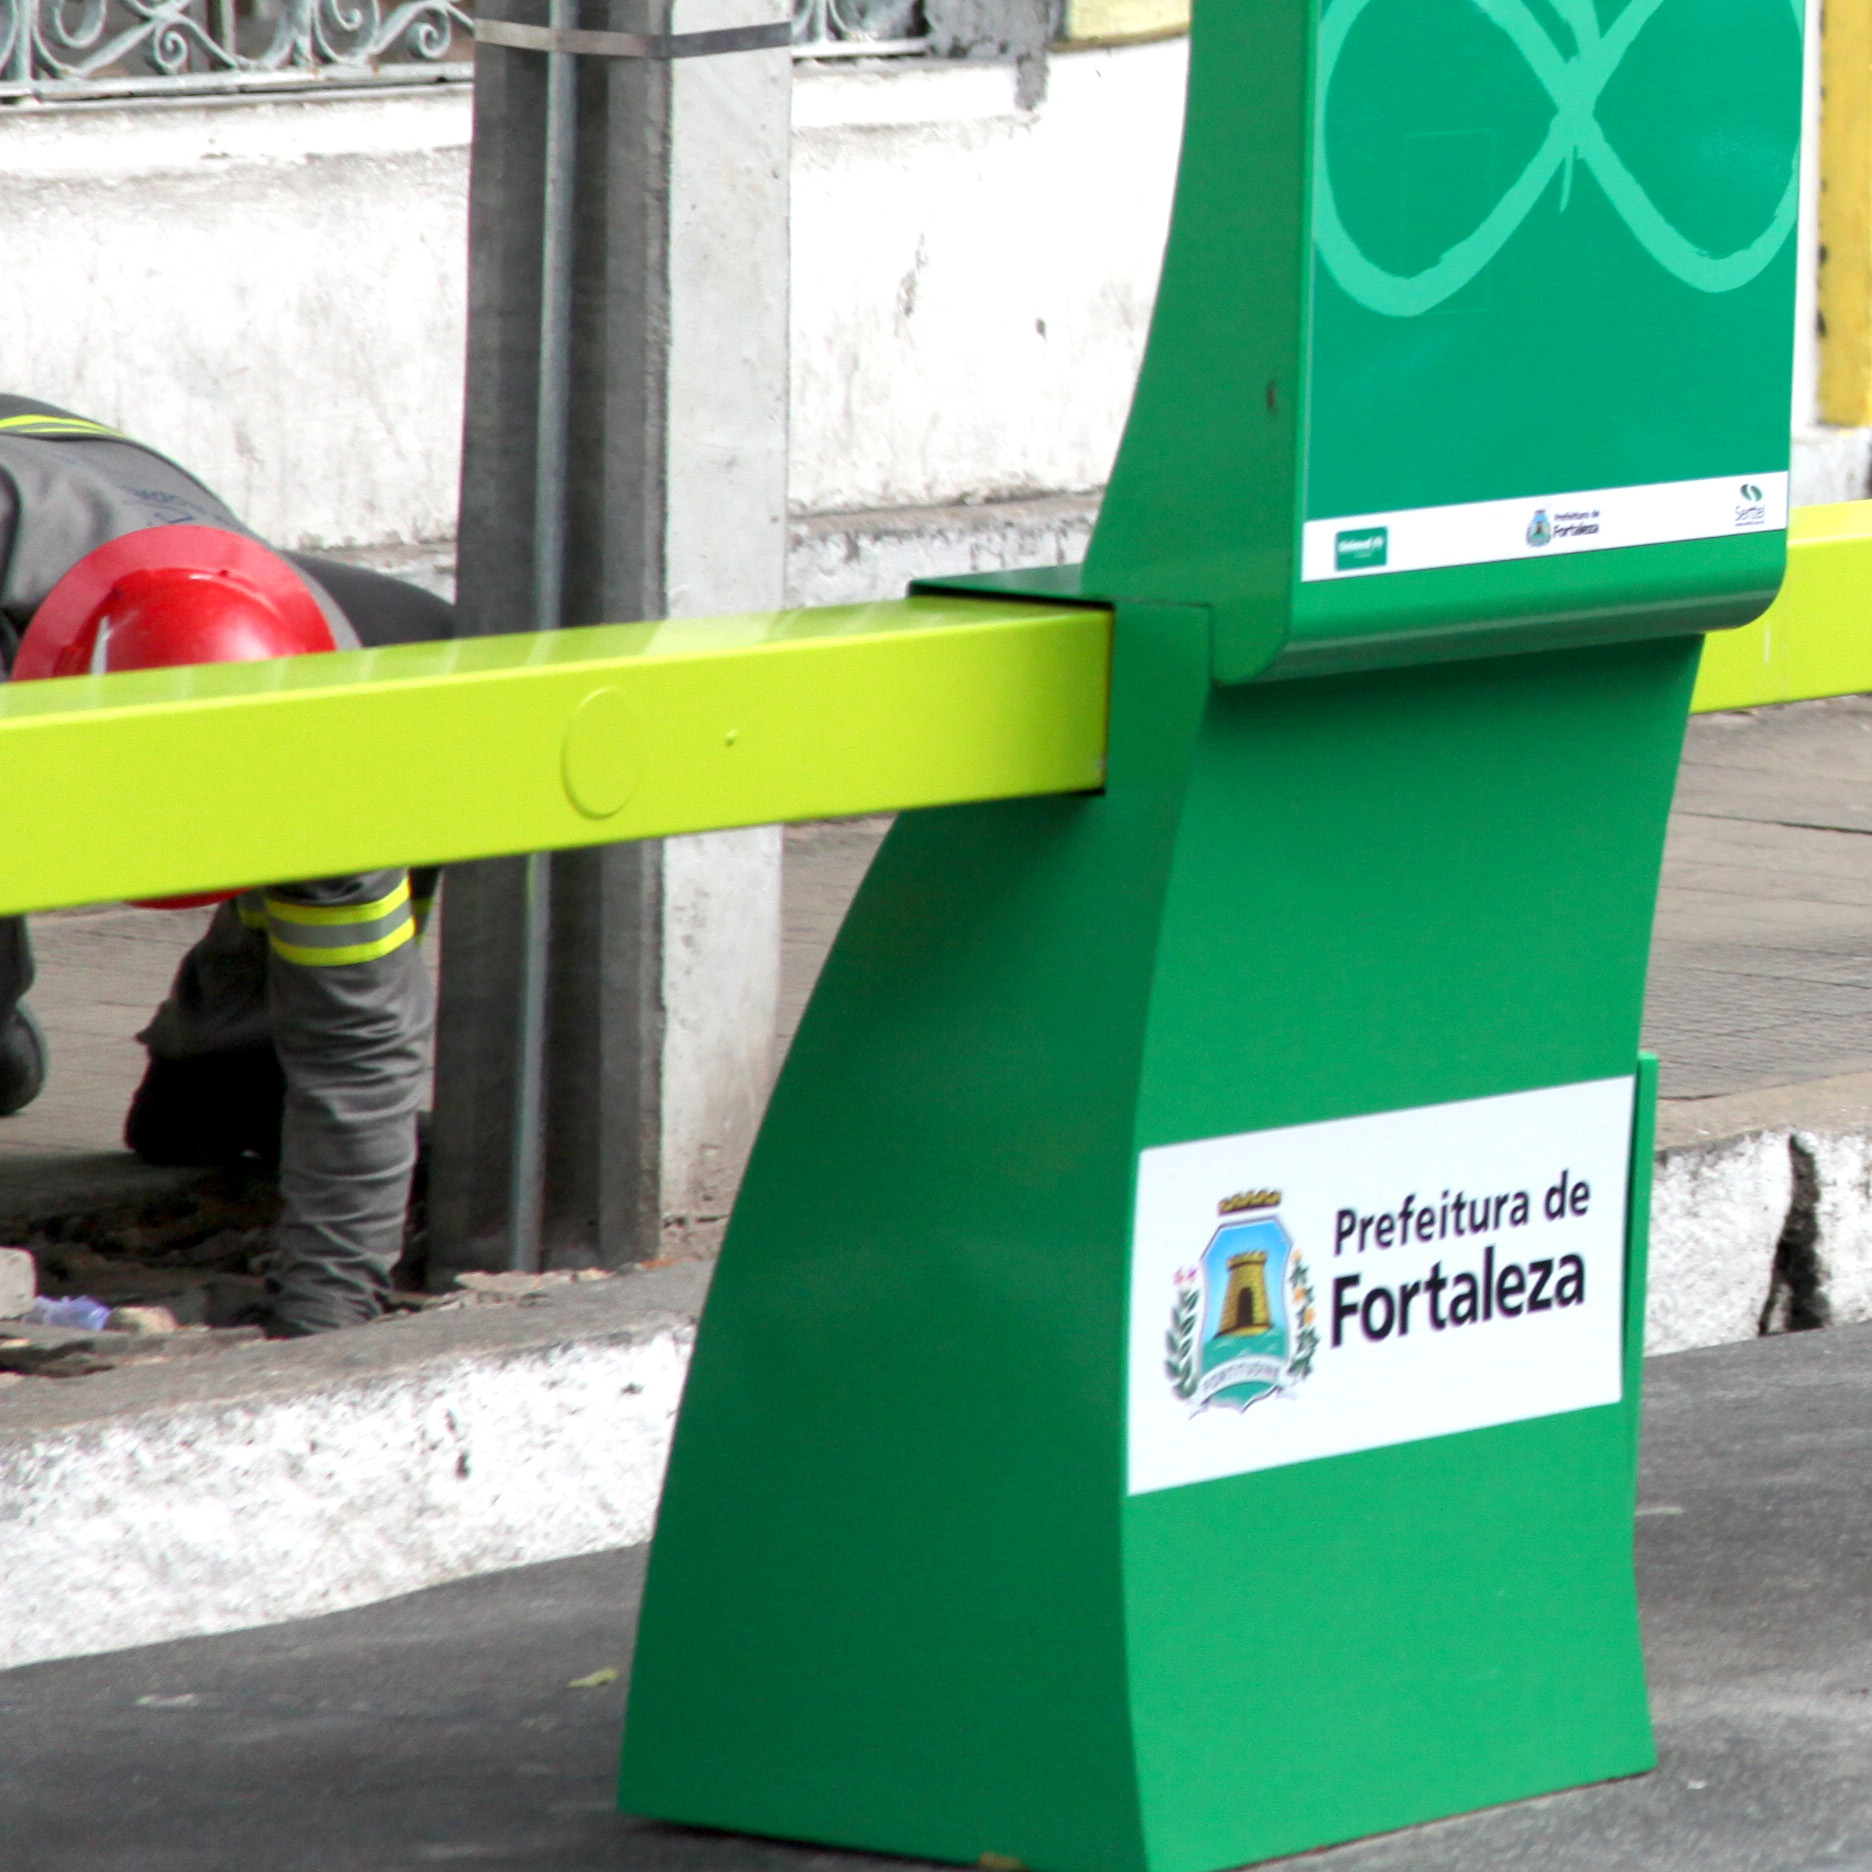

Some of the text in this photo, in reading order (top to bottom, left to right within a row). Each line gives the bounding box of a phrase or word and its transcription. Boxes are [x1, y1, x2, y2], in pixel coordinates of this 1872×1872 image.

[1333, 1169, 1592, 1257] Prefeitura de
[1330, 1243, 1586, 1348] Fortaleza
